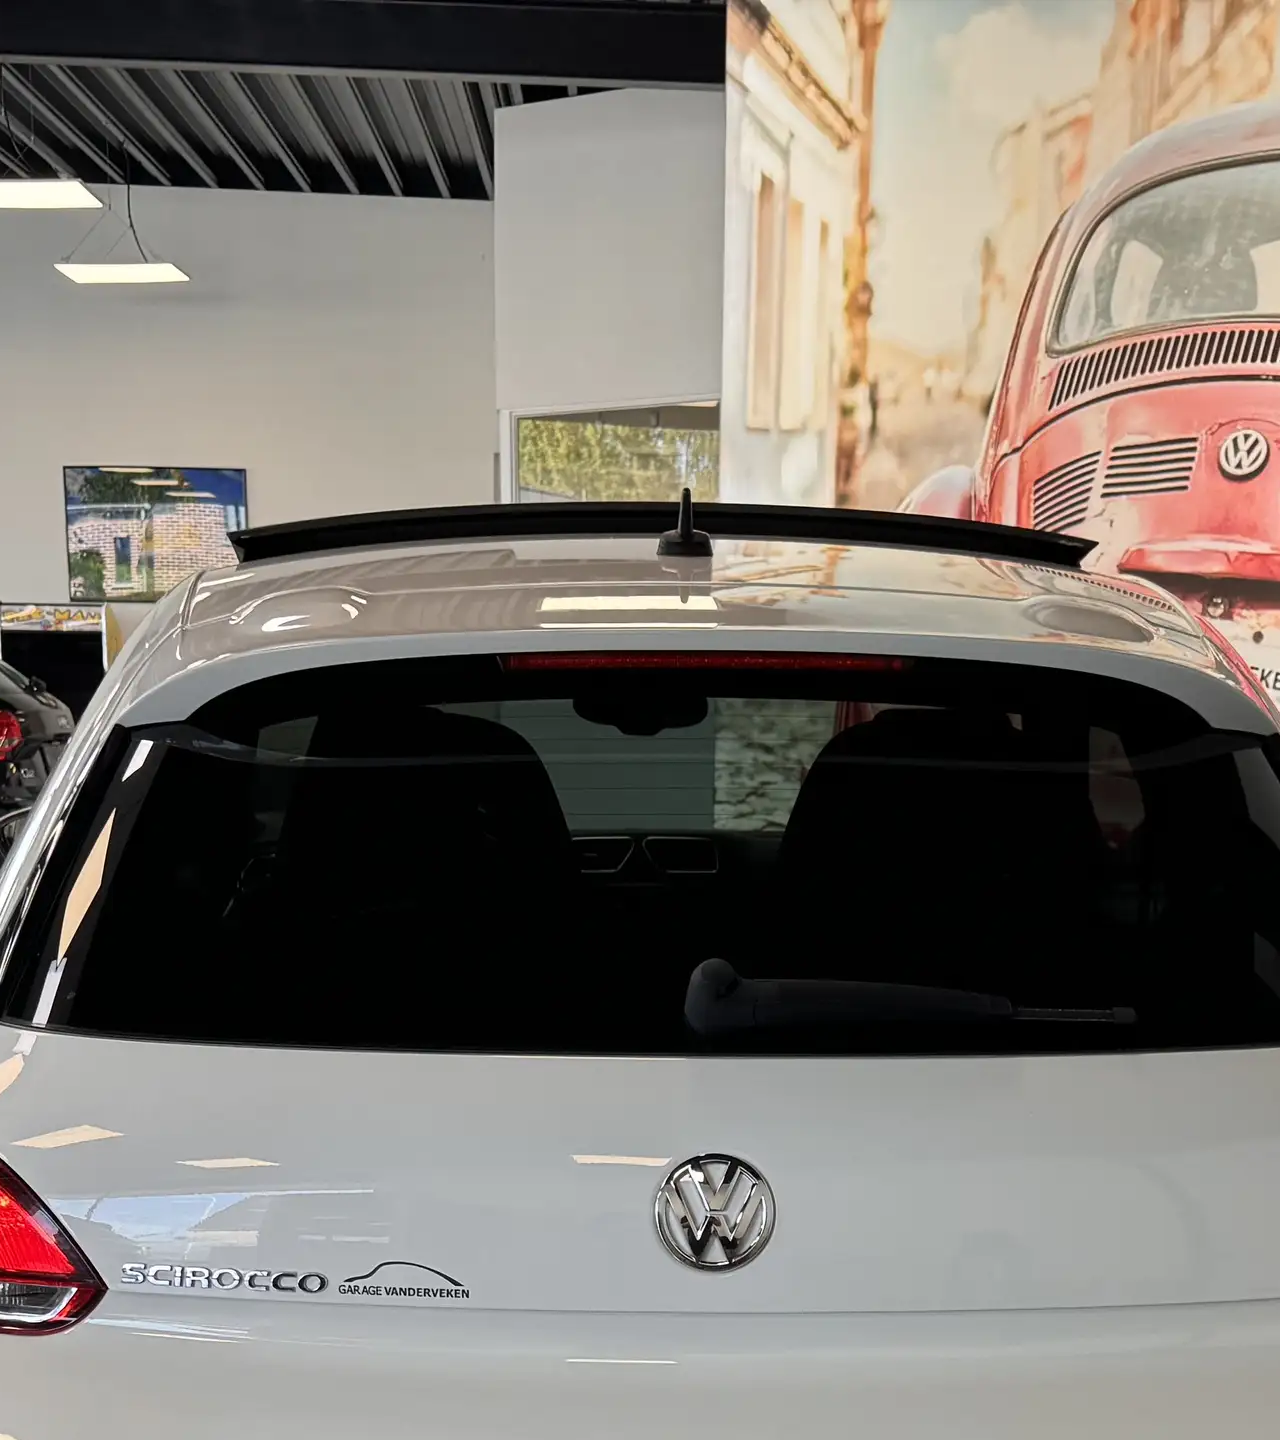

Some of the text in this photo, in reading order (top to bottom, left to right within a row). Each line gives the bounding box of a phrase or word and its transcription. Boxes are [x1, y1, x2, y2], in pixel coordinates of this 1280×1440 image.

[120, 1262, 329, 1294] SCIROCCO
[338, 1283, 471, 1299] GARAGE VANDERVEKEN
